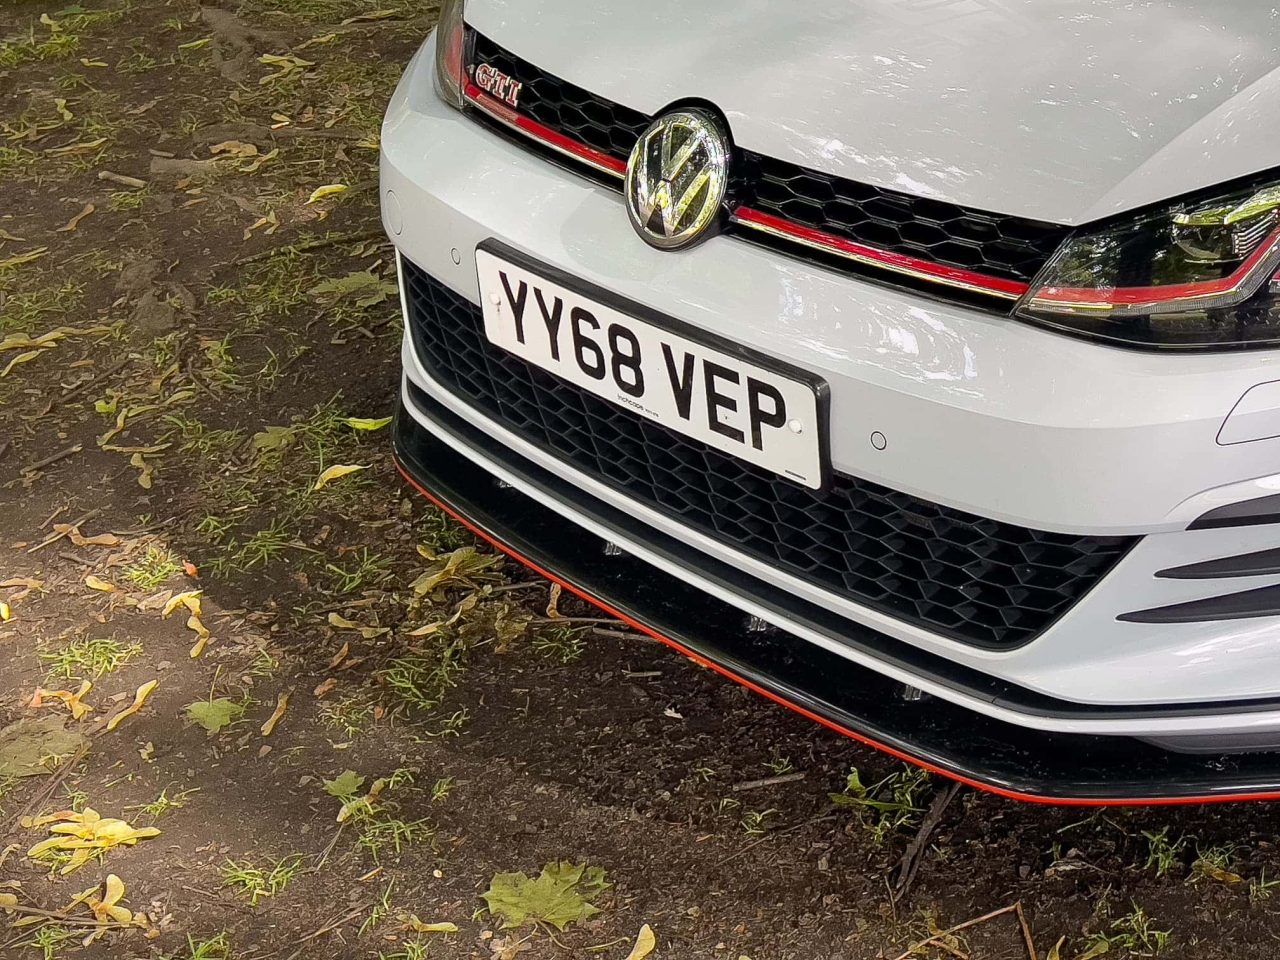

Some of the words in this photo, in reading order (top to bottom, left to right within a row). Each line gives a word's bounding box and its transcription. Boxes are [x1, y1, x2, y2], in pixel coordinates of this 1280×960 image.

[475, 62, 523, 109] GTI
[498, 269, 646, 399] YY68
[659, 340, 788, 453] VEP
